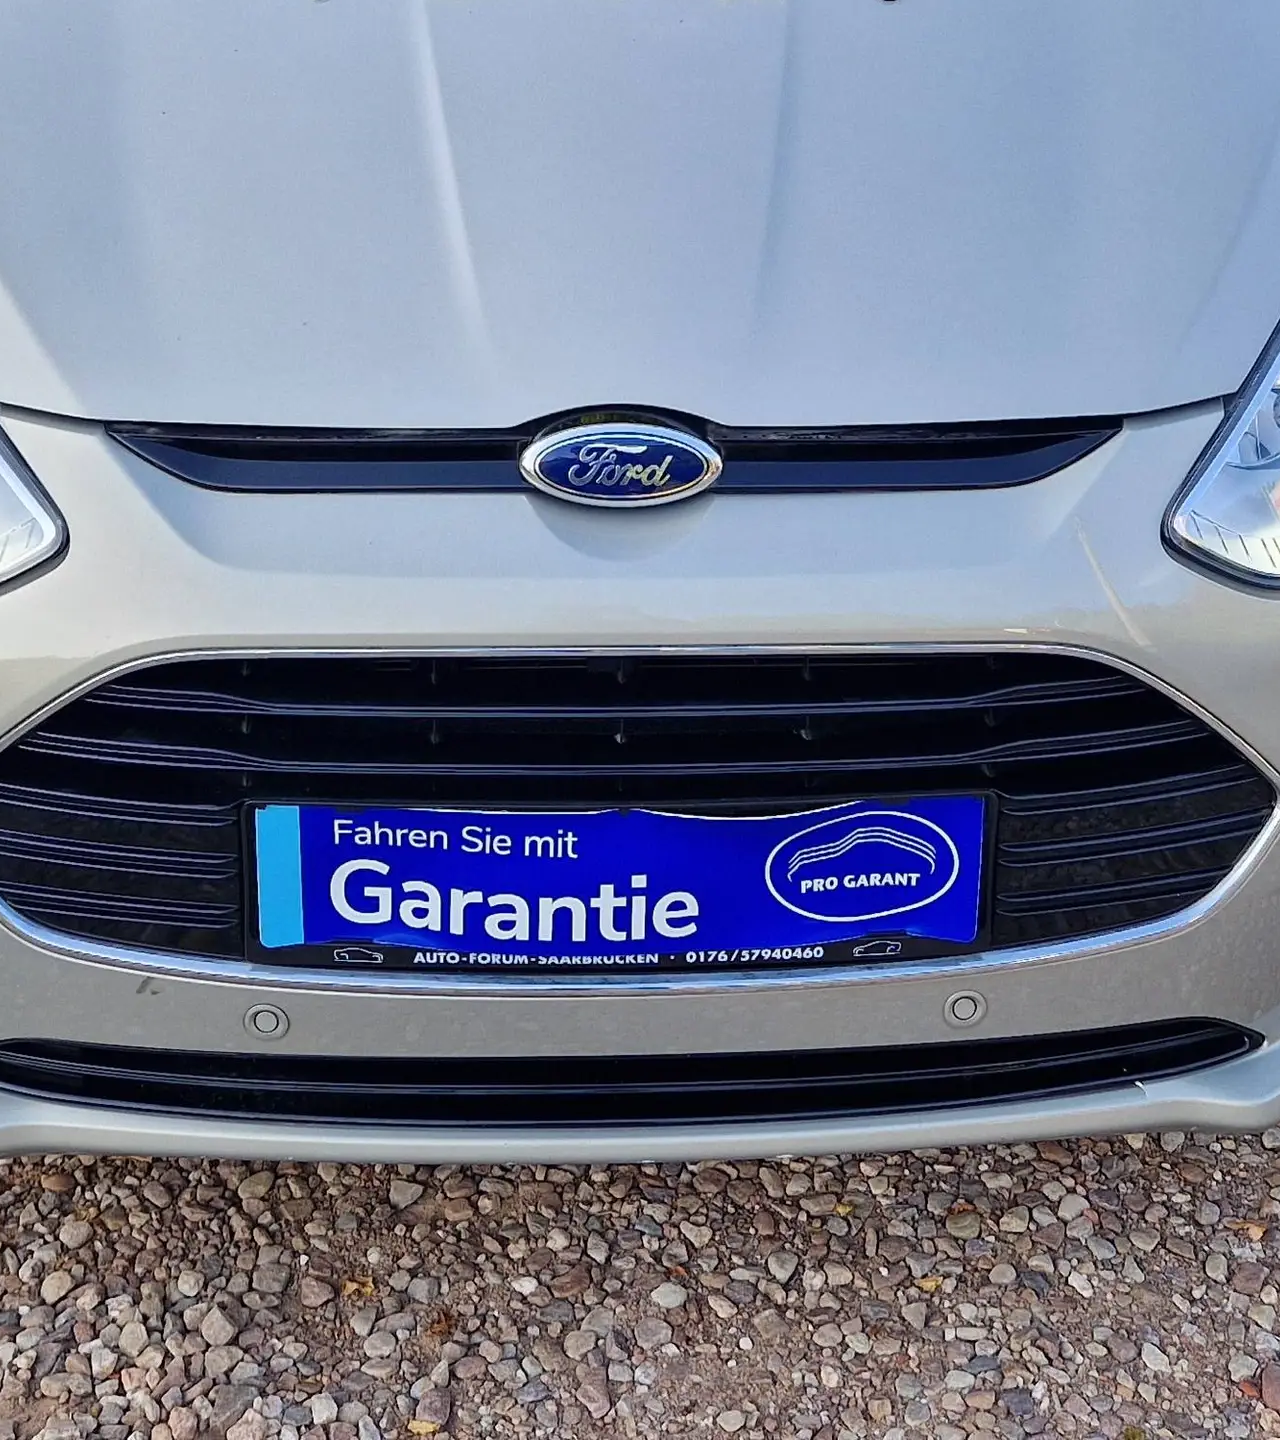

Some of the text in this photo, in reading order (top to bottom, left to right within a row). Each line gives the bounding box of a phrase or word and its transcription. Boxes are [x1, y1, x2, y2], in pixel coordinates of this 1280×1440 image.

[568, 443, 674, 486] Ford
[333, 819, 579, 859] Fahren Sie mit
[329, 858, 700, 942] Garantie
[800, 872, 921, 894] PRO GARANT
[685, 946, 825, 963] 0176/57940460
